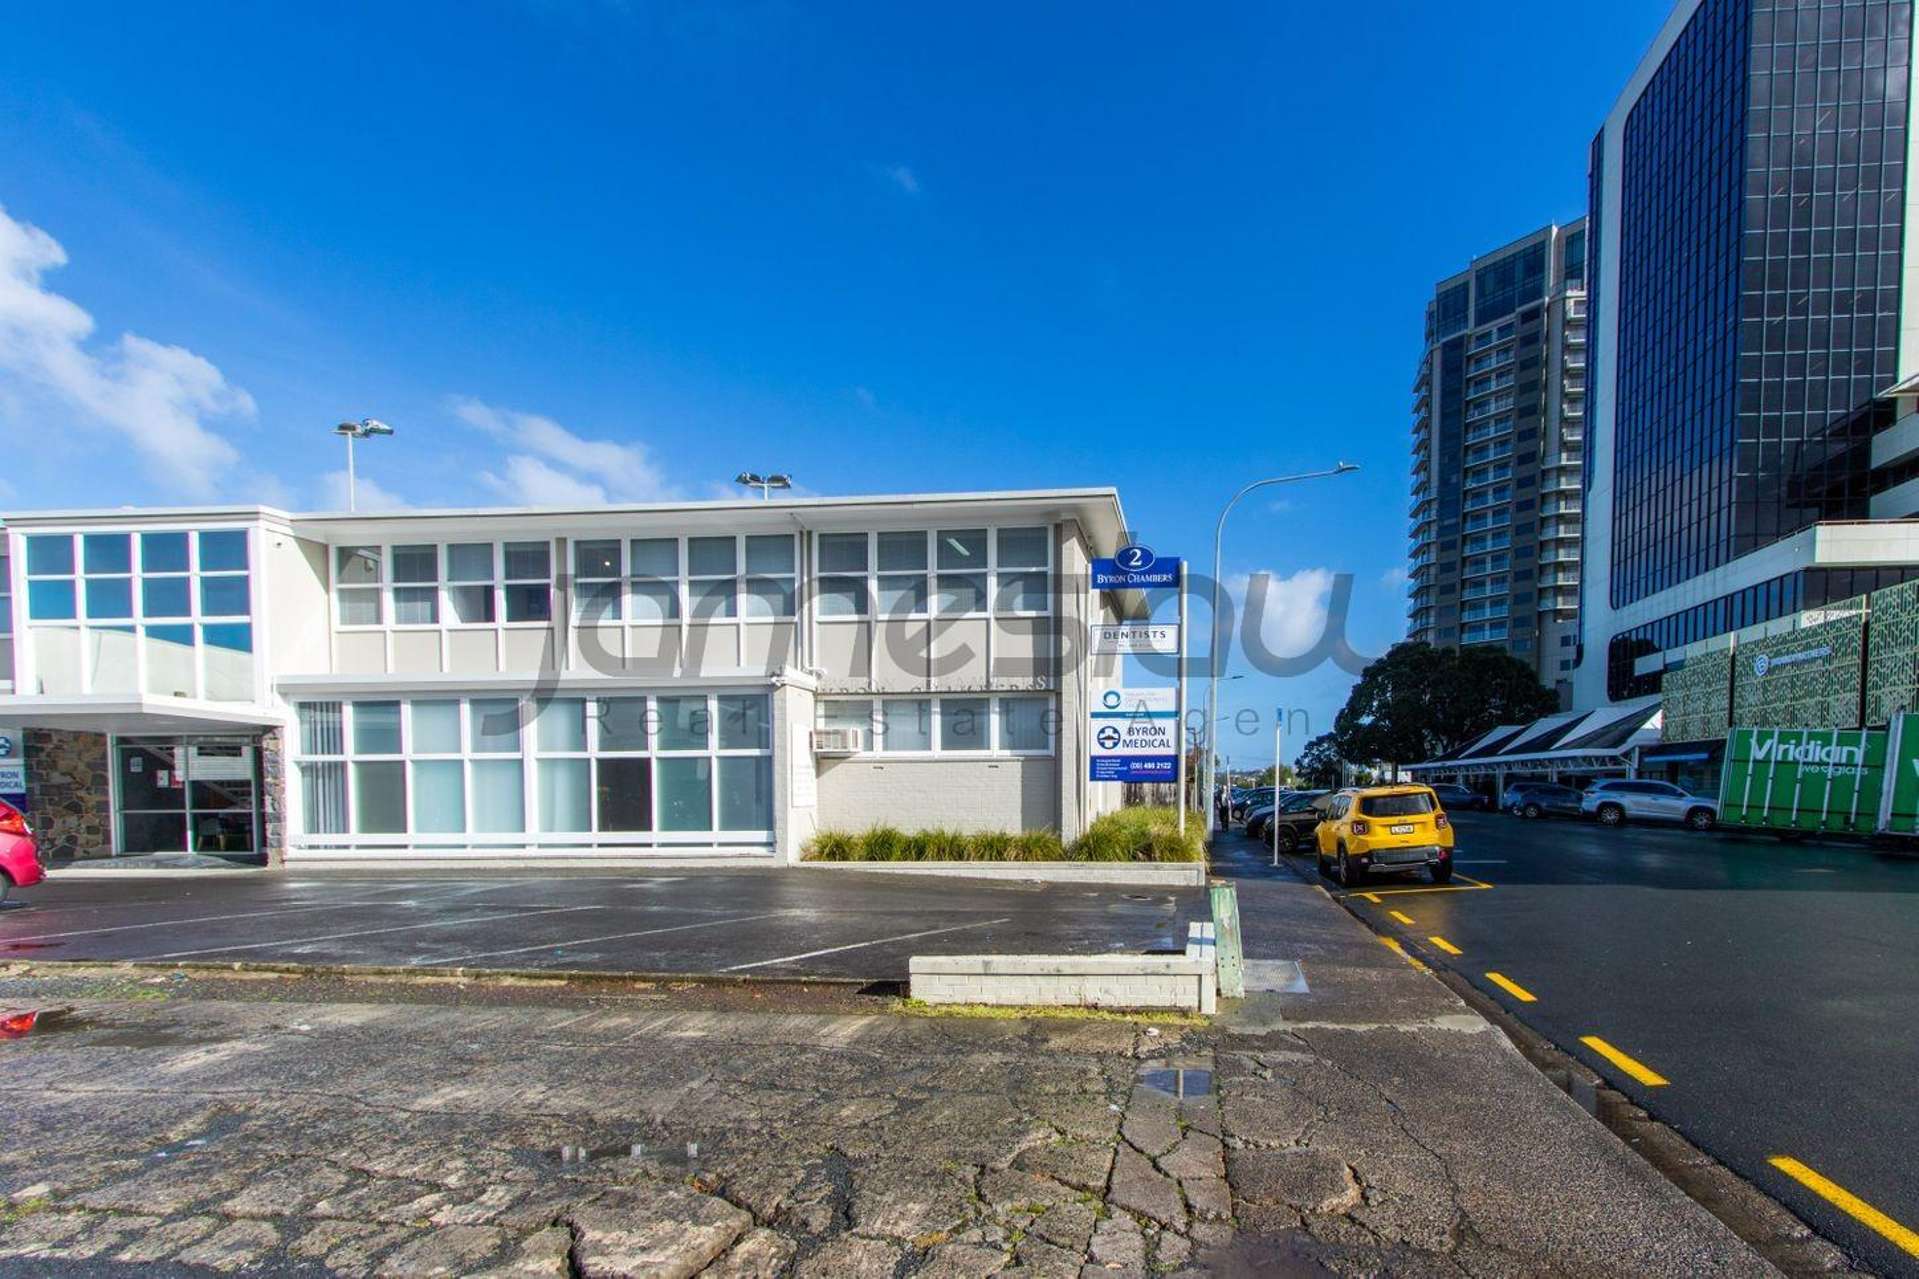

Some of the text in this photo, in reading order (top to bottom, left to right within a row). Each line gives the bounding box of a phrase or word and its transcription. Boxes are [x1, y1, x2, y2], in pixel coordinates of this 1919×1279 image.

[1128, 548, 1142, 566] 2
[1097, 572, 1173, 584] BYRON CHAMBERS
[1103, 630, 1167, 640] DENTISTS
[1127, 726, 1166, 736] BYRON
[1122, 738, 1172, 749] MEDICAL
[1749, 738, 1862, 764] Vridian
